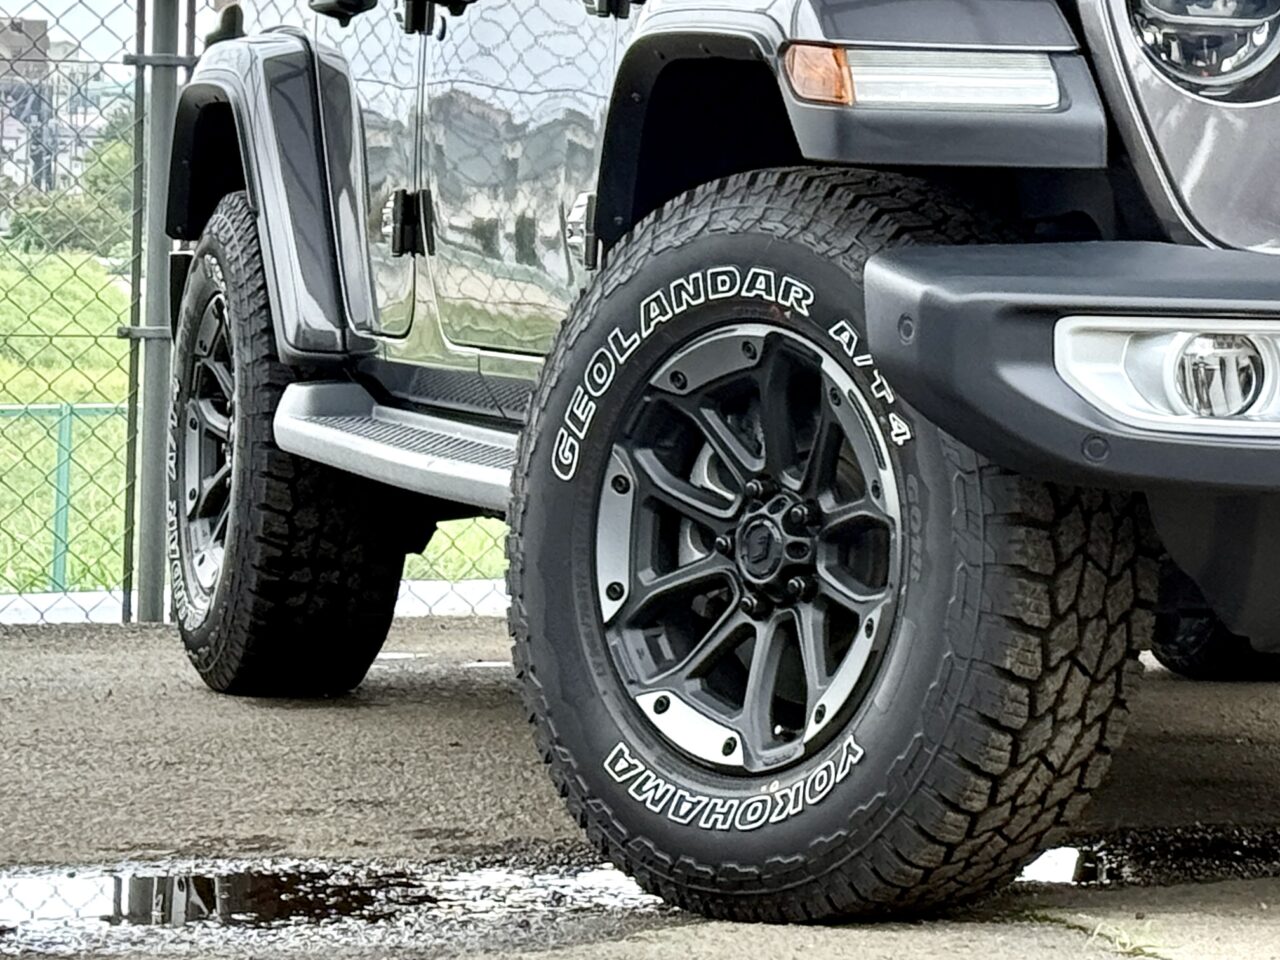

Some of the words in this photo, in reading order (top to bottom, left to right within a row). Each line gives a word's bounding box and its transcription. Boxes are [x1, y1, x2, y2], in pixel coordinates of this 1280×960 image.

[552, 265, 815, 481] GEOLANDAR
[829, 320, 912, 446] A/T4
[603, 734, 866, 831] YOKOHAMA
